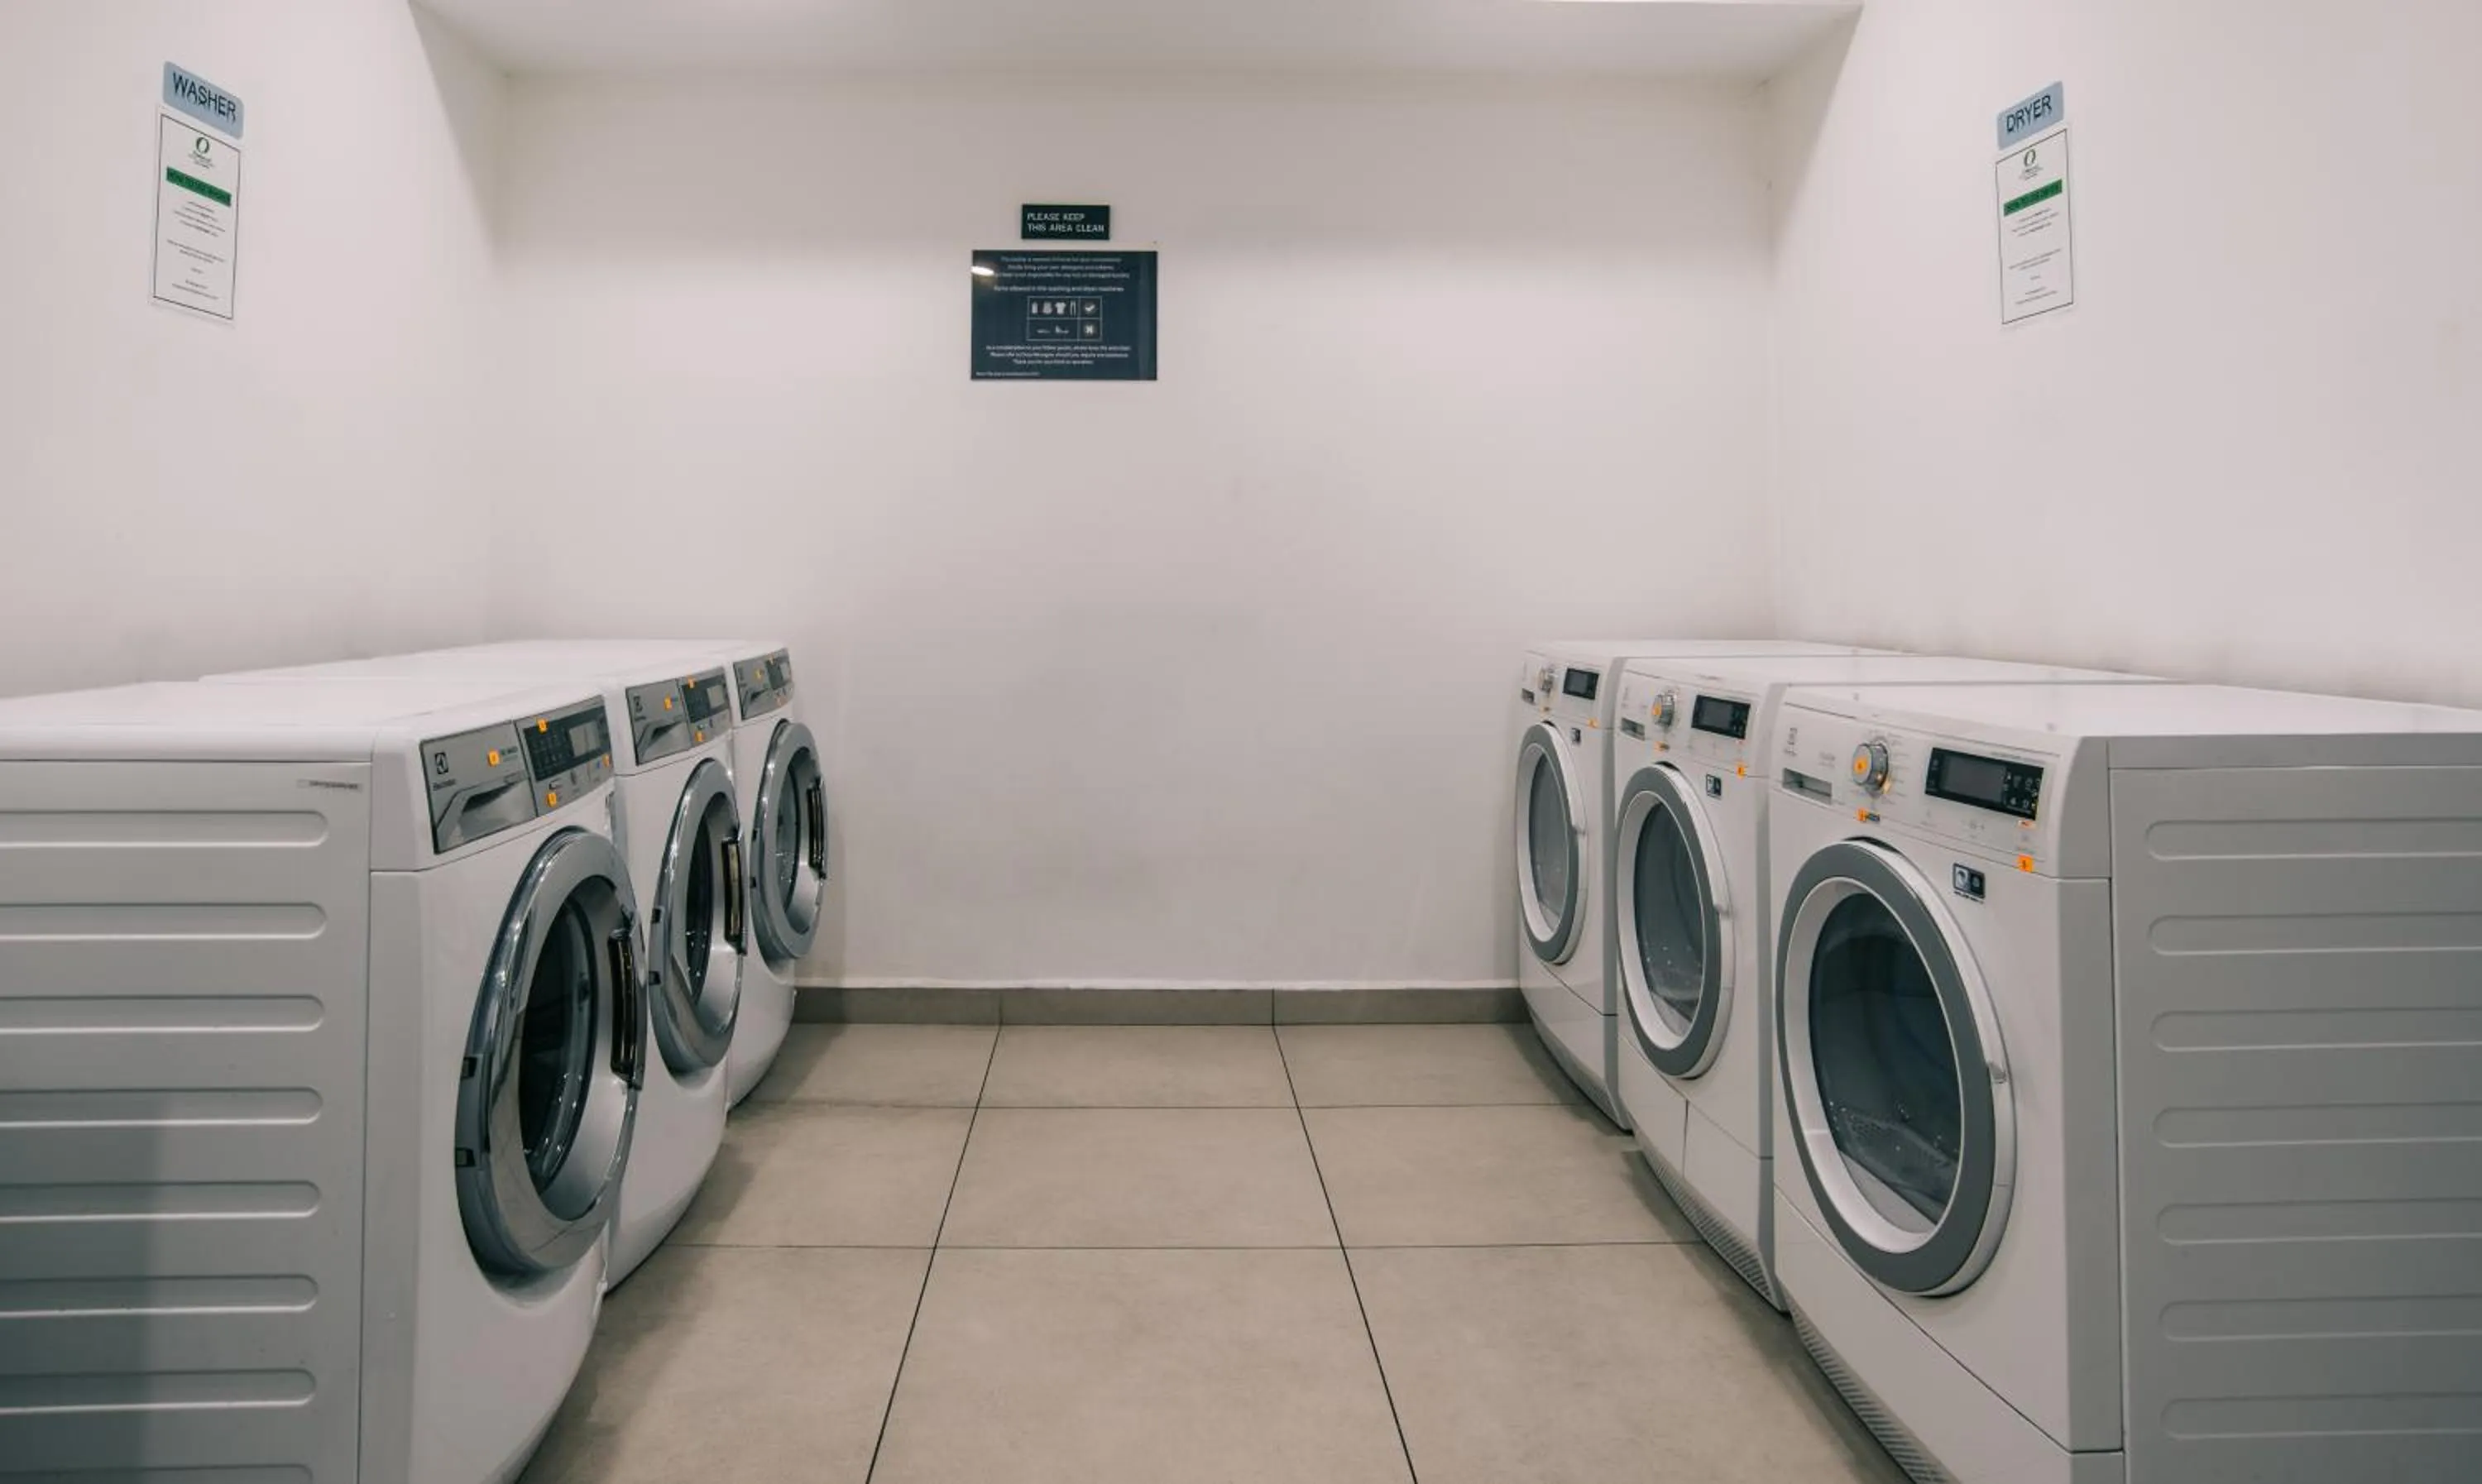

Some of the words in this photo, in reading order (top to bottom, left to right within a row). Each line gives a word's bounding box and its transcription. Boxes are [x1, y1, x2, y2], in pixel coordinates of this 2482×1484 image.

[173, 71, 236, 124] WASHER
[2006, 94, 2052, 133] DRYER
[1027, 212, 1060, 221] PLEASE
[1062, 212, 1085, 221] KEEP
[1027, 223, 1046, 232] THIS
[1049, 223, 1073, 232] AREA
[1076, 224, 1104, 232] CLEAN
